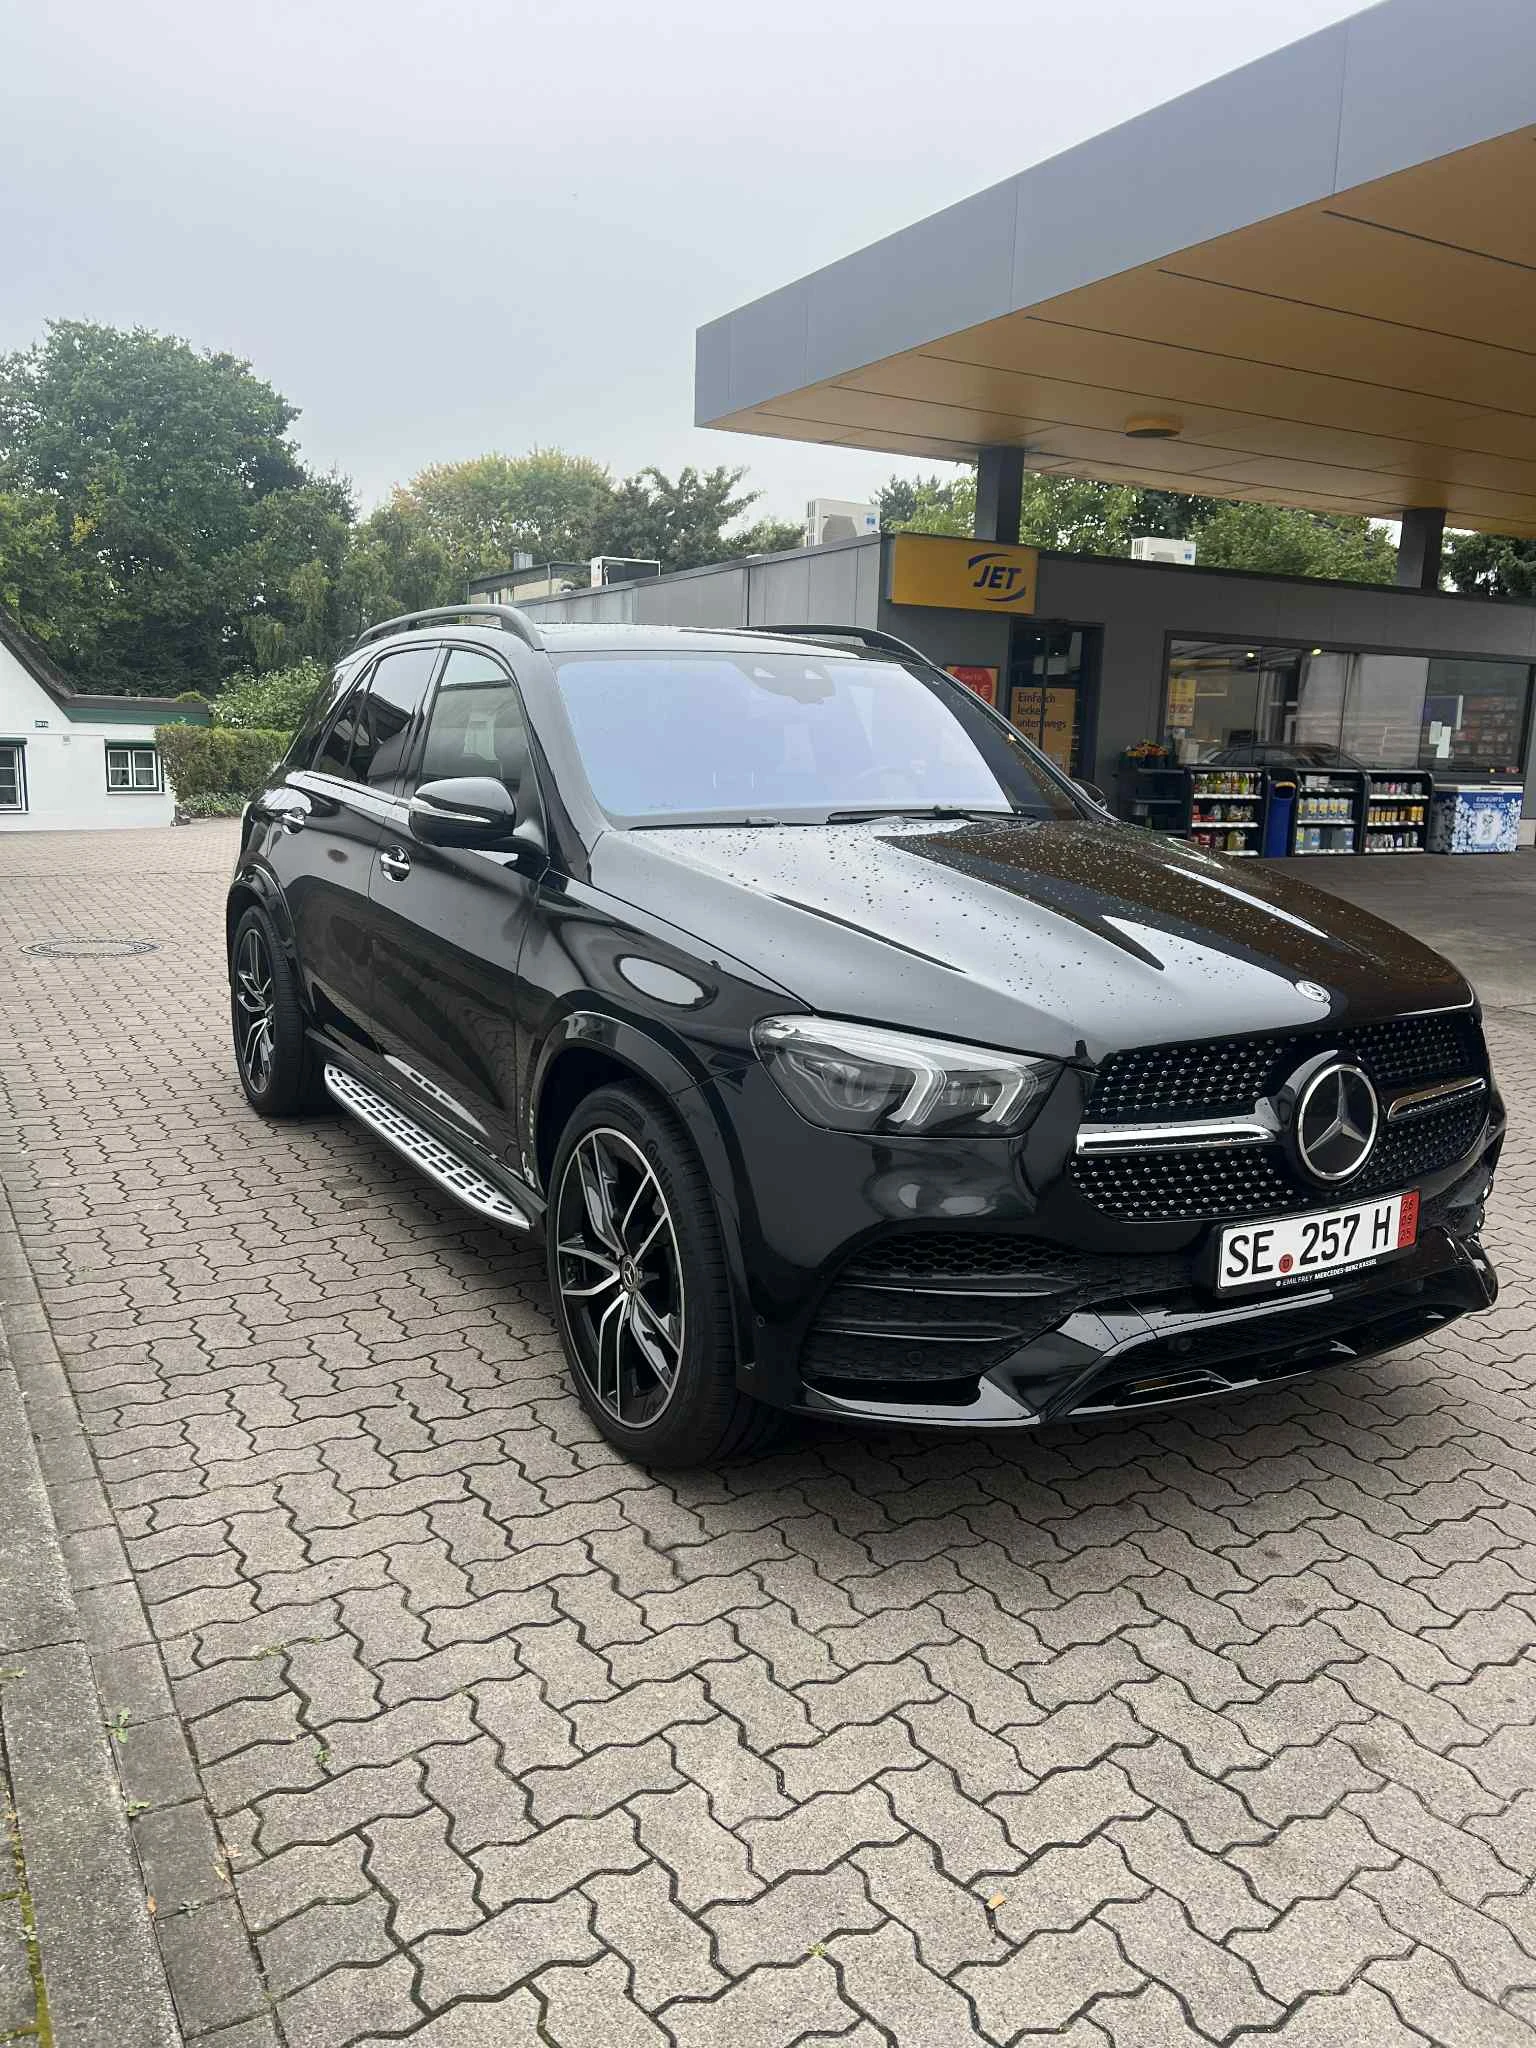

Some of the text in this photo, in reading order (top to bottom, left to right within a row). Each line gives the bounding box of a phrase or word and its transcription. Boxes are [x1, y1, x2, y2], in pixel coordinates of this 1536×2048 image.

[973, 565, 1023, 590] JET
[1226, 1205, 1393, 1278] SE 257 H
